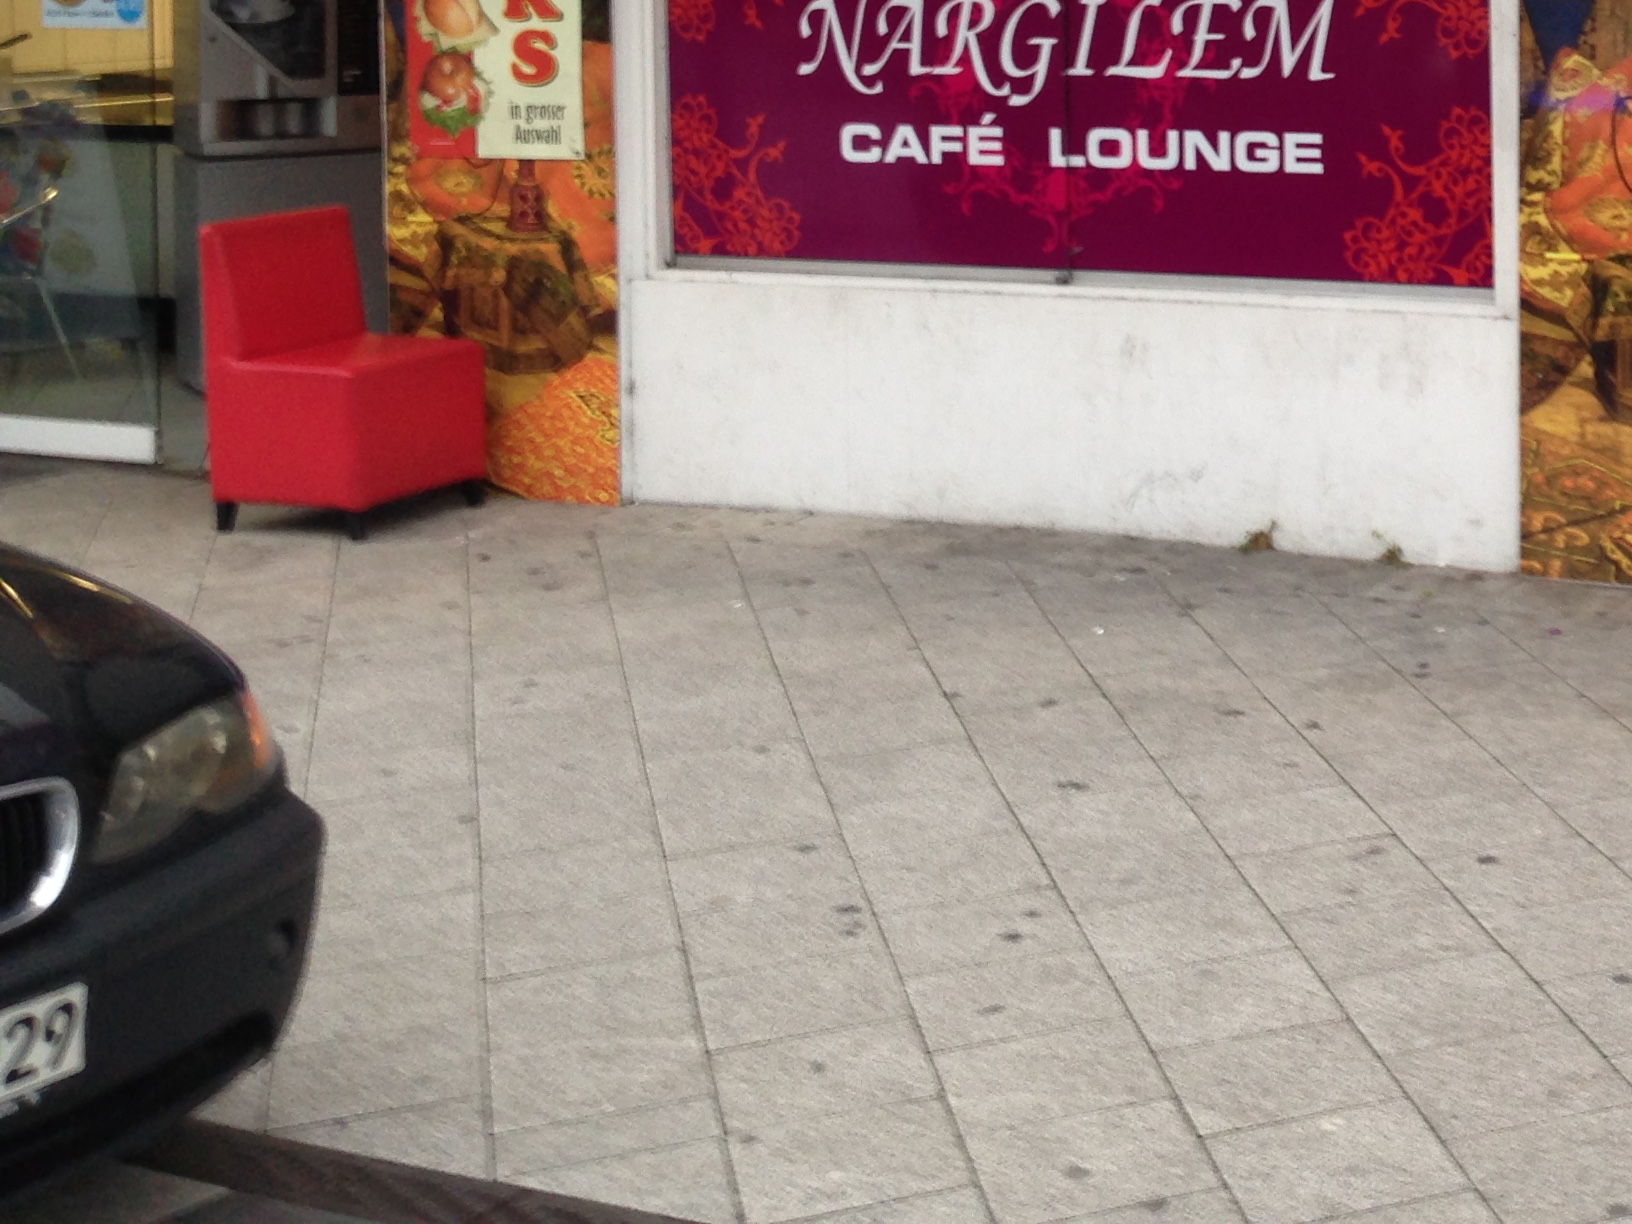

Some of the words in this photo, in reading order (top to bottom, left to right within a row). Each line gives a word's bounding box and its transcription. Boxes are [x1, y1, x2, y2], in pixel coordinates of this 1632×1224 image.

[507, 99, 521, 120] in
[513, 124, 562, 145] Auswahl
[839, 113, 1005, 166] CAFÉ
[1049, 126, 1325, 175] LOUNGE
[4, 998, 79, 1084] 29
